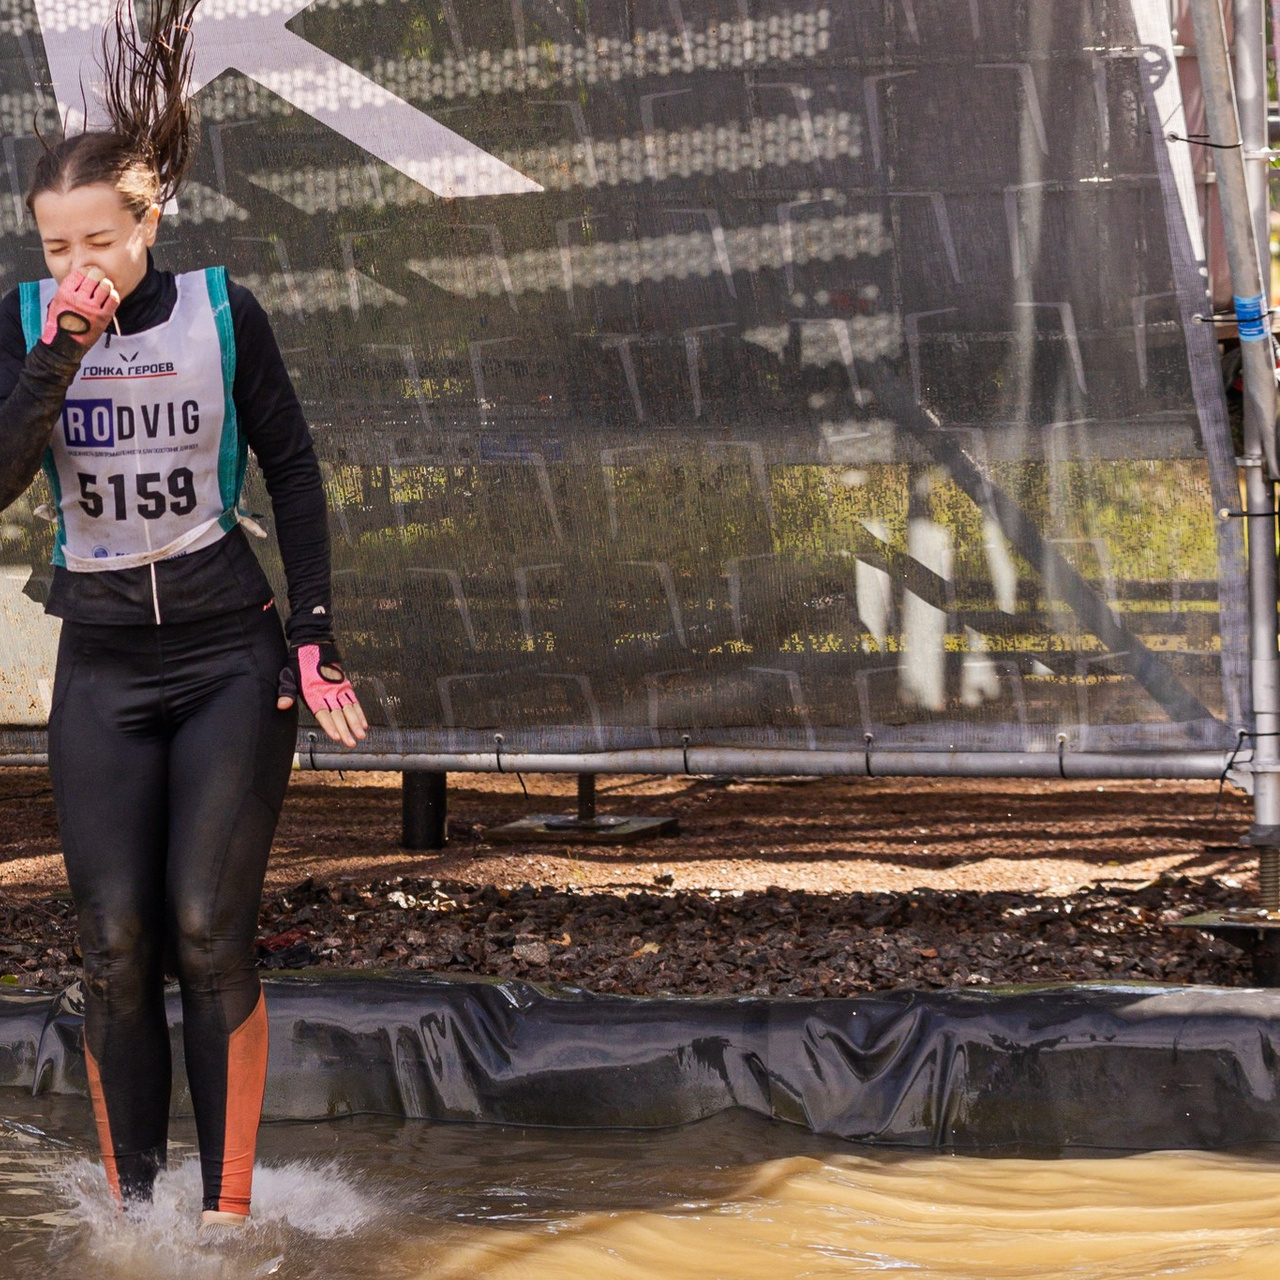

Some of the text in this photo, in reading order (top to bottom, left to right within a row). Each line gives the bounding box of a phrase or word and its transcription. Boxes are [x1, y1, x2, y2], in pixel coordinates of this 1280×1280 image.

[83, 362, 174, 377] ГОНКА ГЕРОЕВ
[66, 400, 200, 442] RODVIG
[77, 466, 197, 521] 5159
